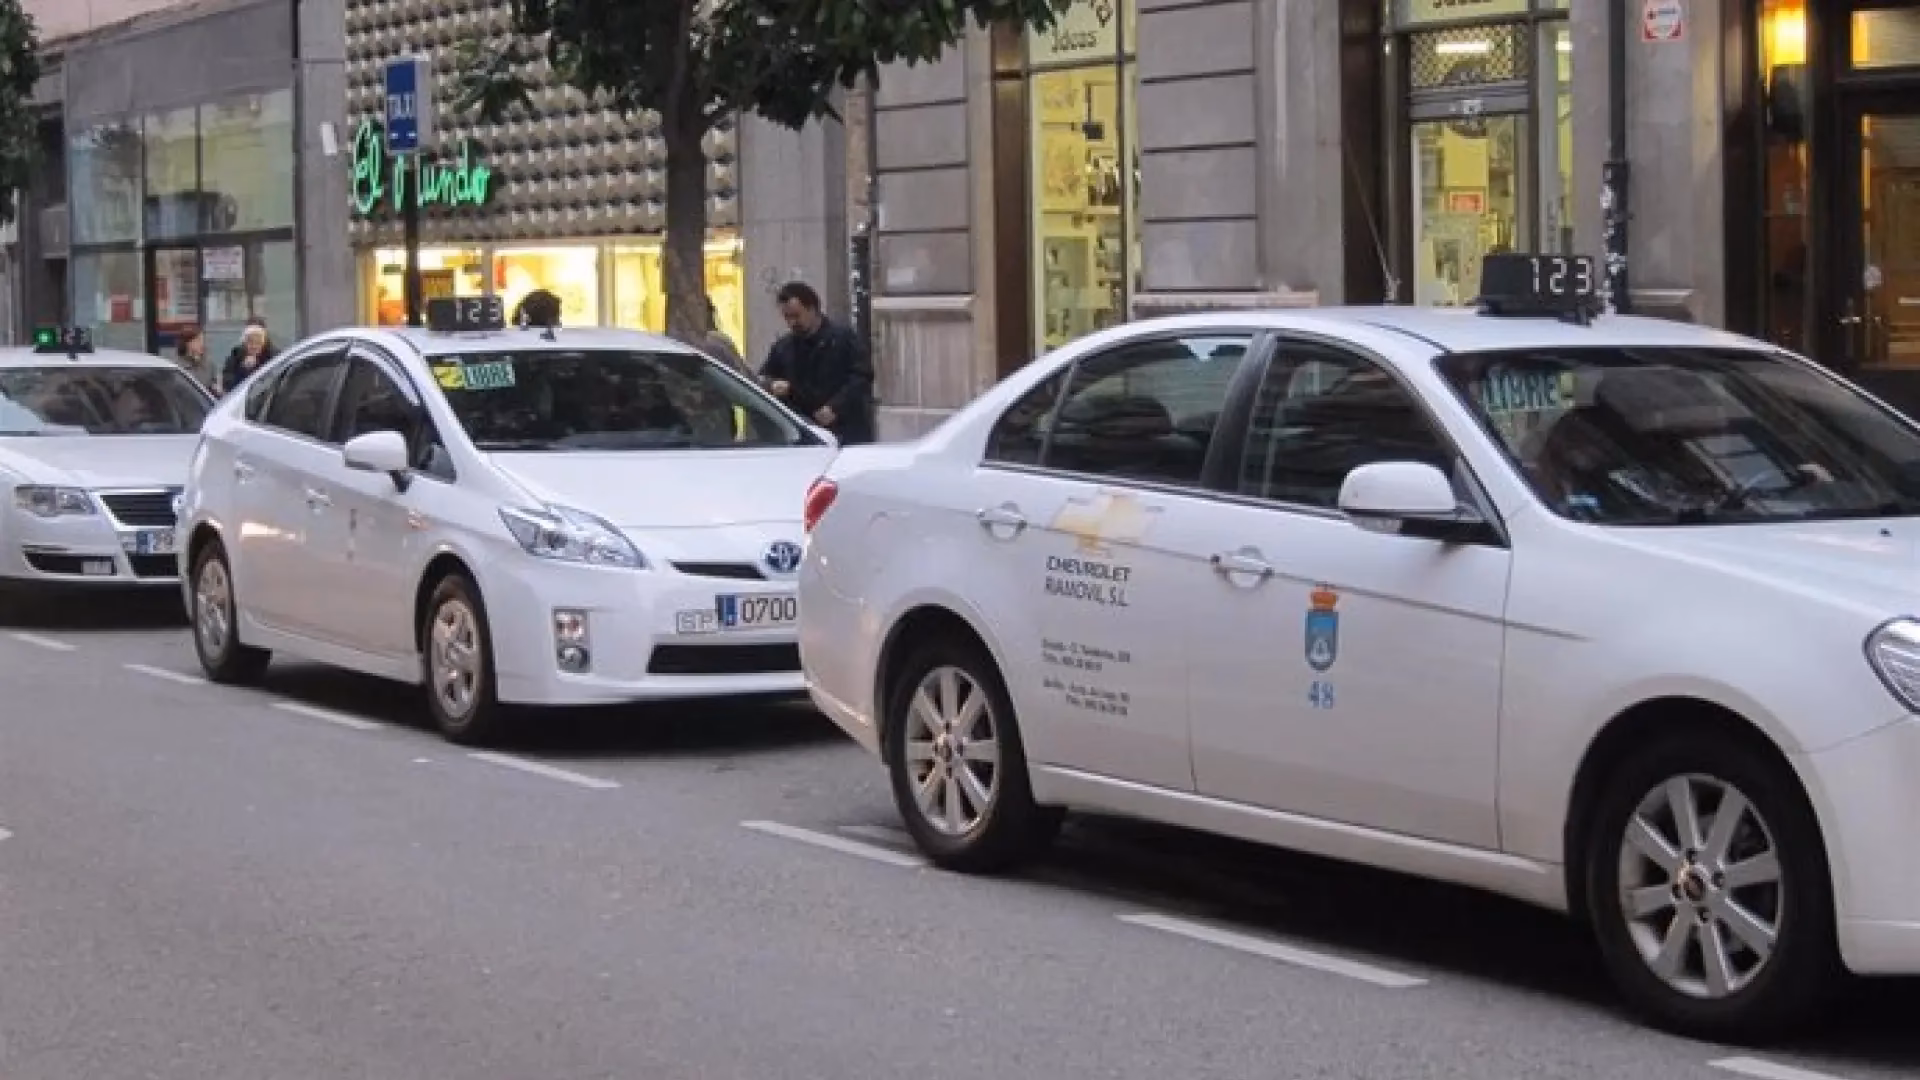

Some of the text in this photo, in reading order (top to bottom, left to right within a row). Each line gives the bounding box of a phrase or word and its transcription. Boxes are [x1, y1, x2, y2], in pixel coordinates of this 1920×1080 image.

[388, 90, 415, 118] TAXI
[353, 115, 385, 214] El
[1530, 257, 1592, 293] 123
[454, 299, 502, 322] 123
[1045, 555, 1131, 581] CHEVROLET
[742, 598, 797, 622] 0700
[1309, 681, 1334, 709] 48
